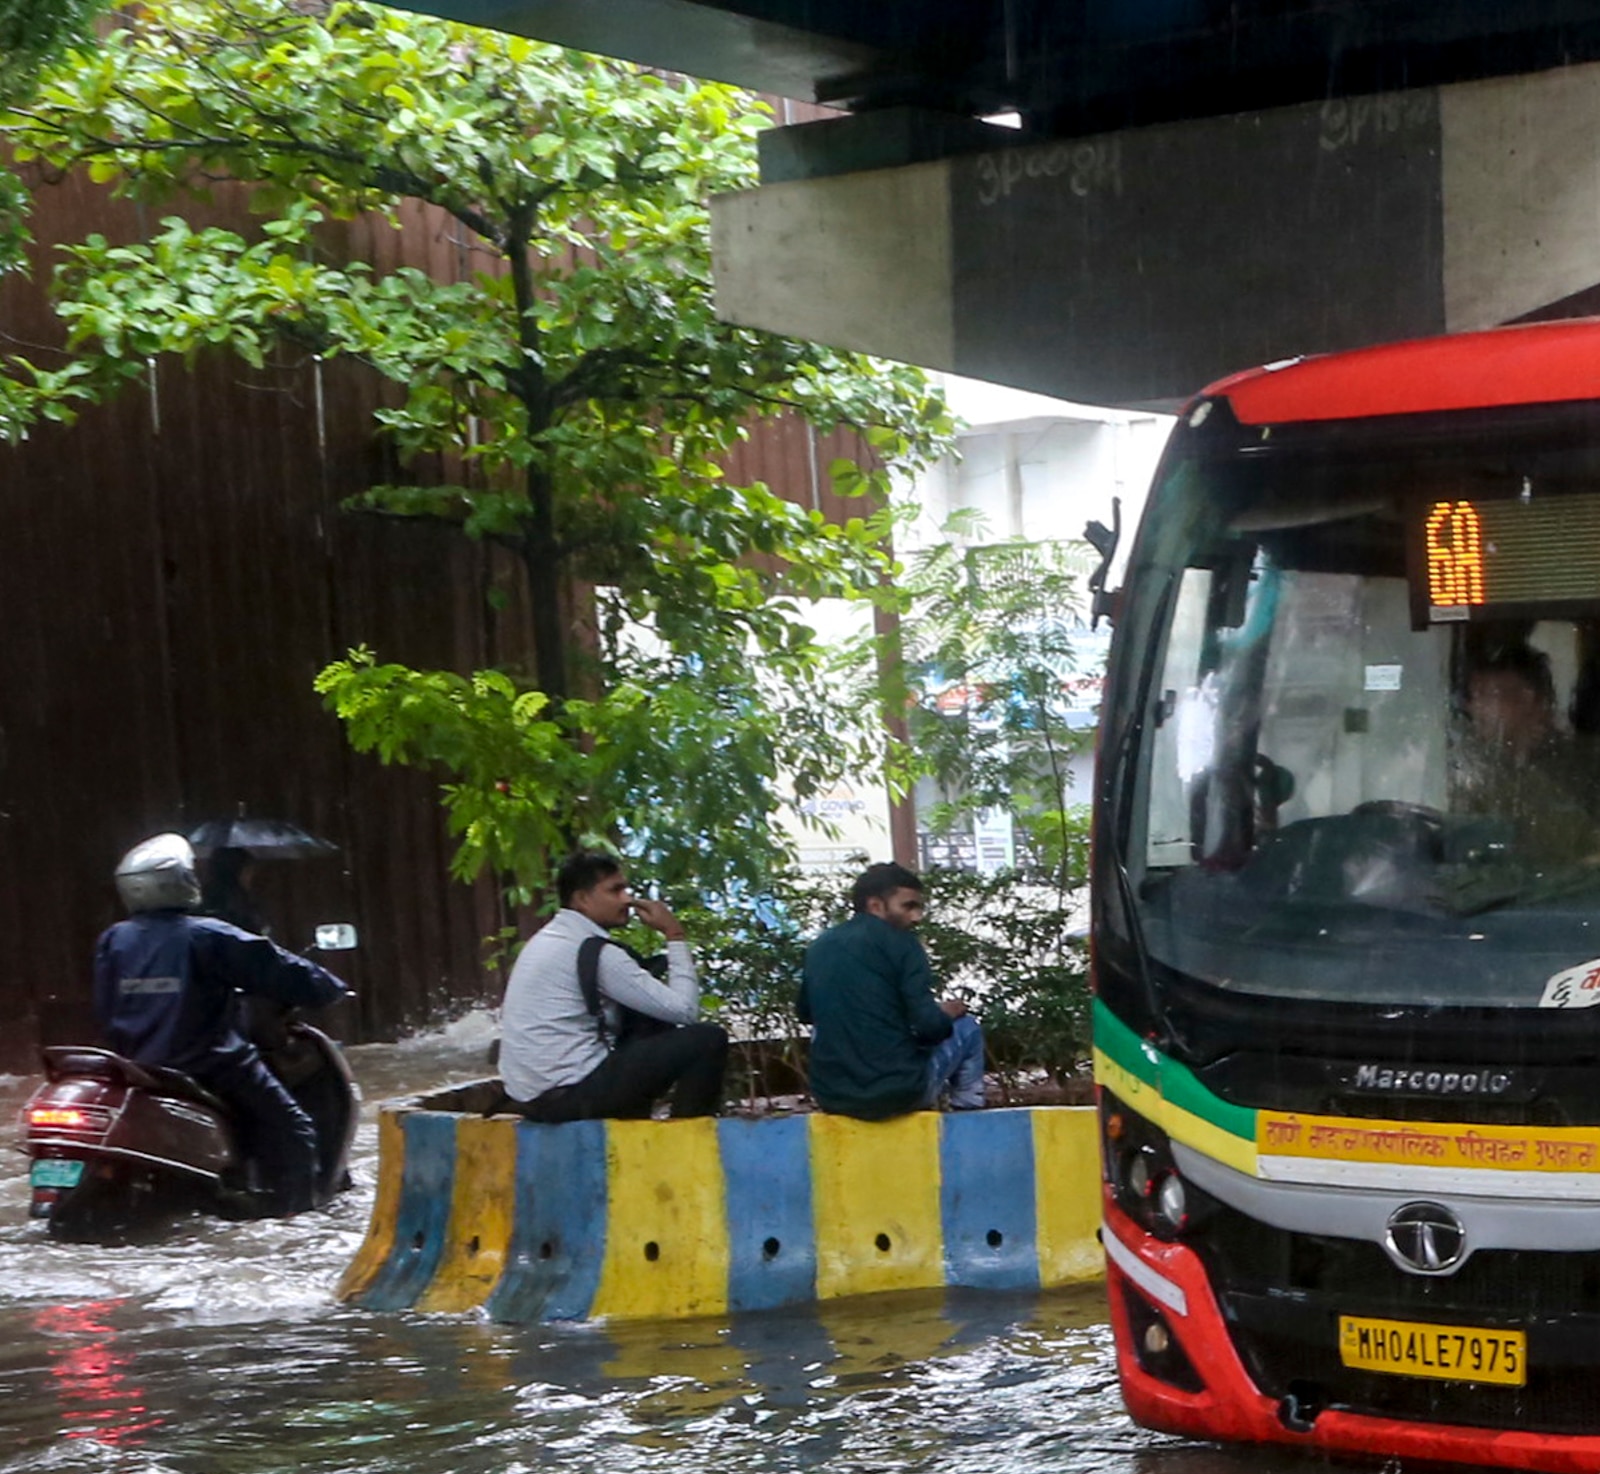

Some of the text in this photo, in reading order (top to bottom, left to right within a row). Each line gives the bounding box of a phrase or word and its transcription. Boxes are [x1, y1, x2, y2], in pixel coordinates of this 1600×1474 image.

[1355, 1065, 1510, 1094] Marcopolo
[1265, 1115, 1302, 1146] ठाणे
[1455, 1129, 1527, 1163] परिवहन
[1358, 1326, 1517, 1374] MH04LE7975
